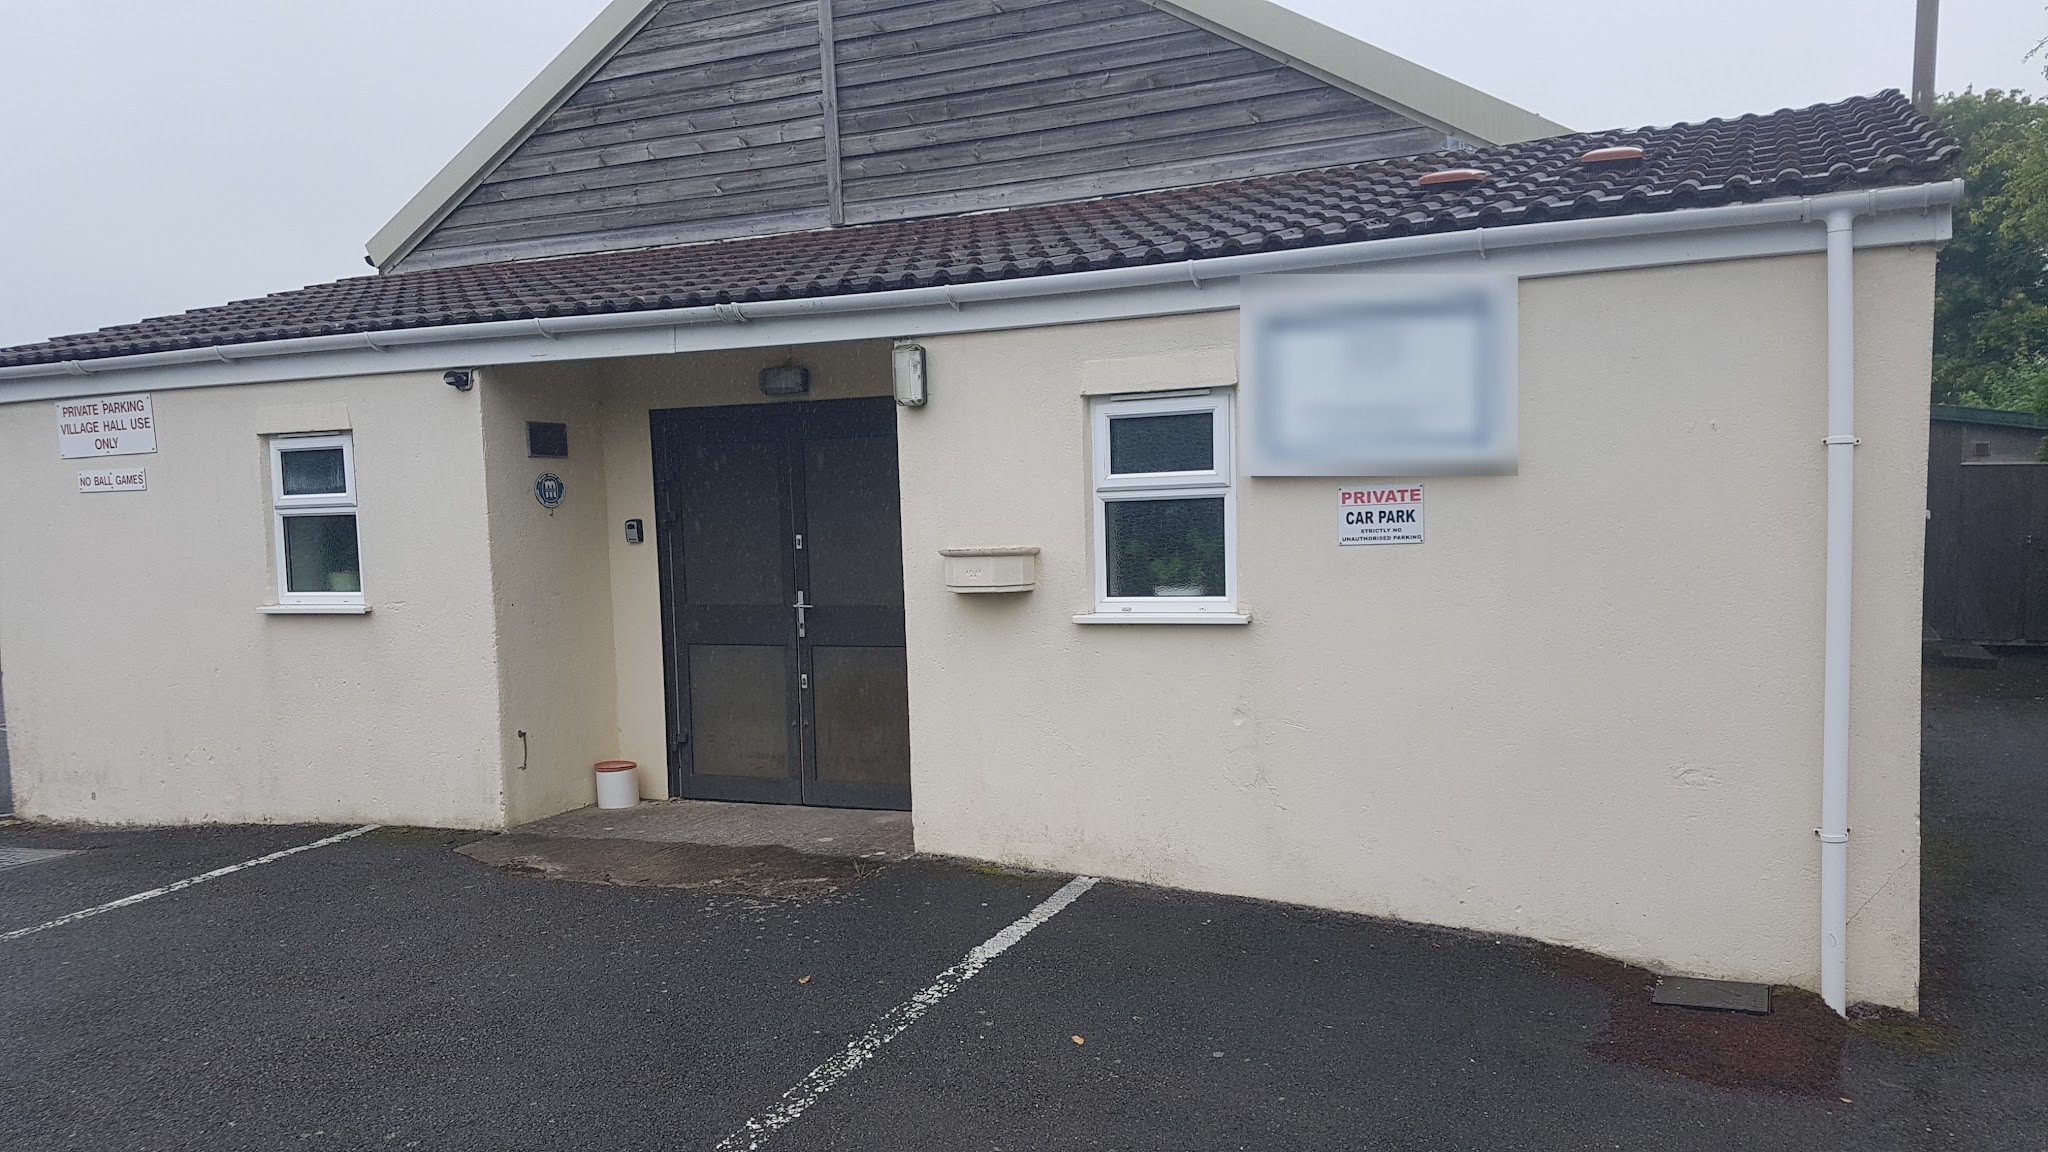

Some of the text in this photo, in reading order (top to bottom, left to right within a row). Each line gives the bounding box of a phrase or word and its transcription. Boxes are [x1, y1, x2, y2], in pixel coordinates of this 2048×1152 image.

[62, 400, 145, 418] PRIVATE PARKING
[60, 417, 151, 435] VILLAGE HALL USE
[94, 437, 119, 450] ONLY
[80, 474, 144, 486] NO BALL GAMES
[1341, 488, 1422, 505] PRIVATE
[1346, 509, 1416, 525] CAR PARK
